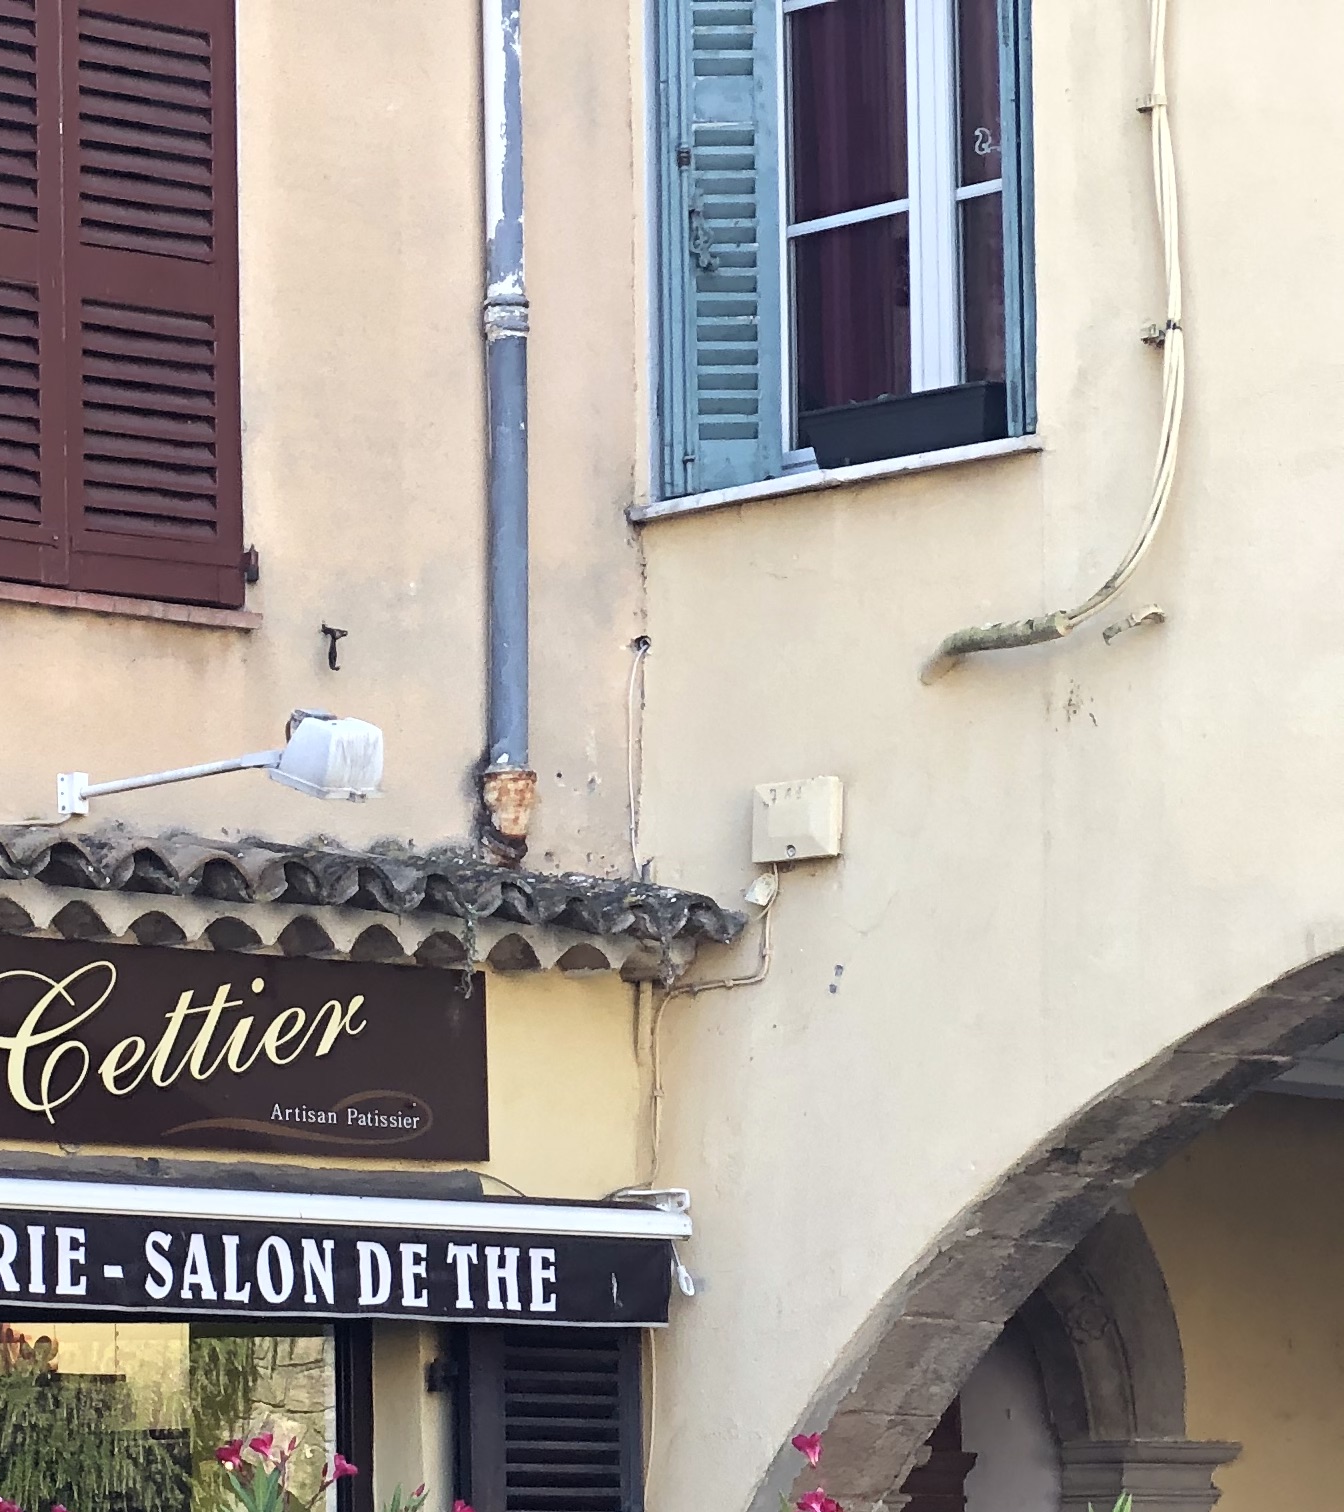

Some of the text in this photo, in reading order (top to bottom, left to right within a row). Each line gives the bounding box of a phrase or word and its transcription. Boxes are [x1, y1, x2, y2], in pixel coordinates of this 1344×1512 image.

[270, 1102, 421, 1129] Artisan Patissier
[143, 1229, 336, 1305] SALON
[356, 1240, 430, 1309] DE
[447, 1241, 558, 1313] THE
